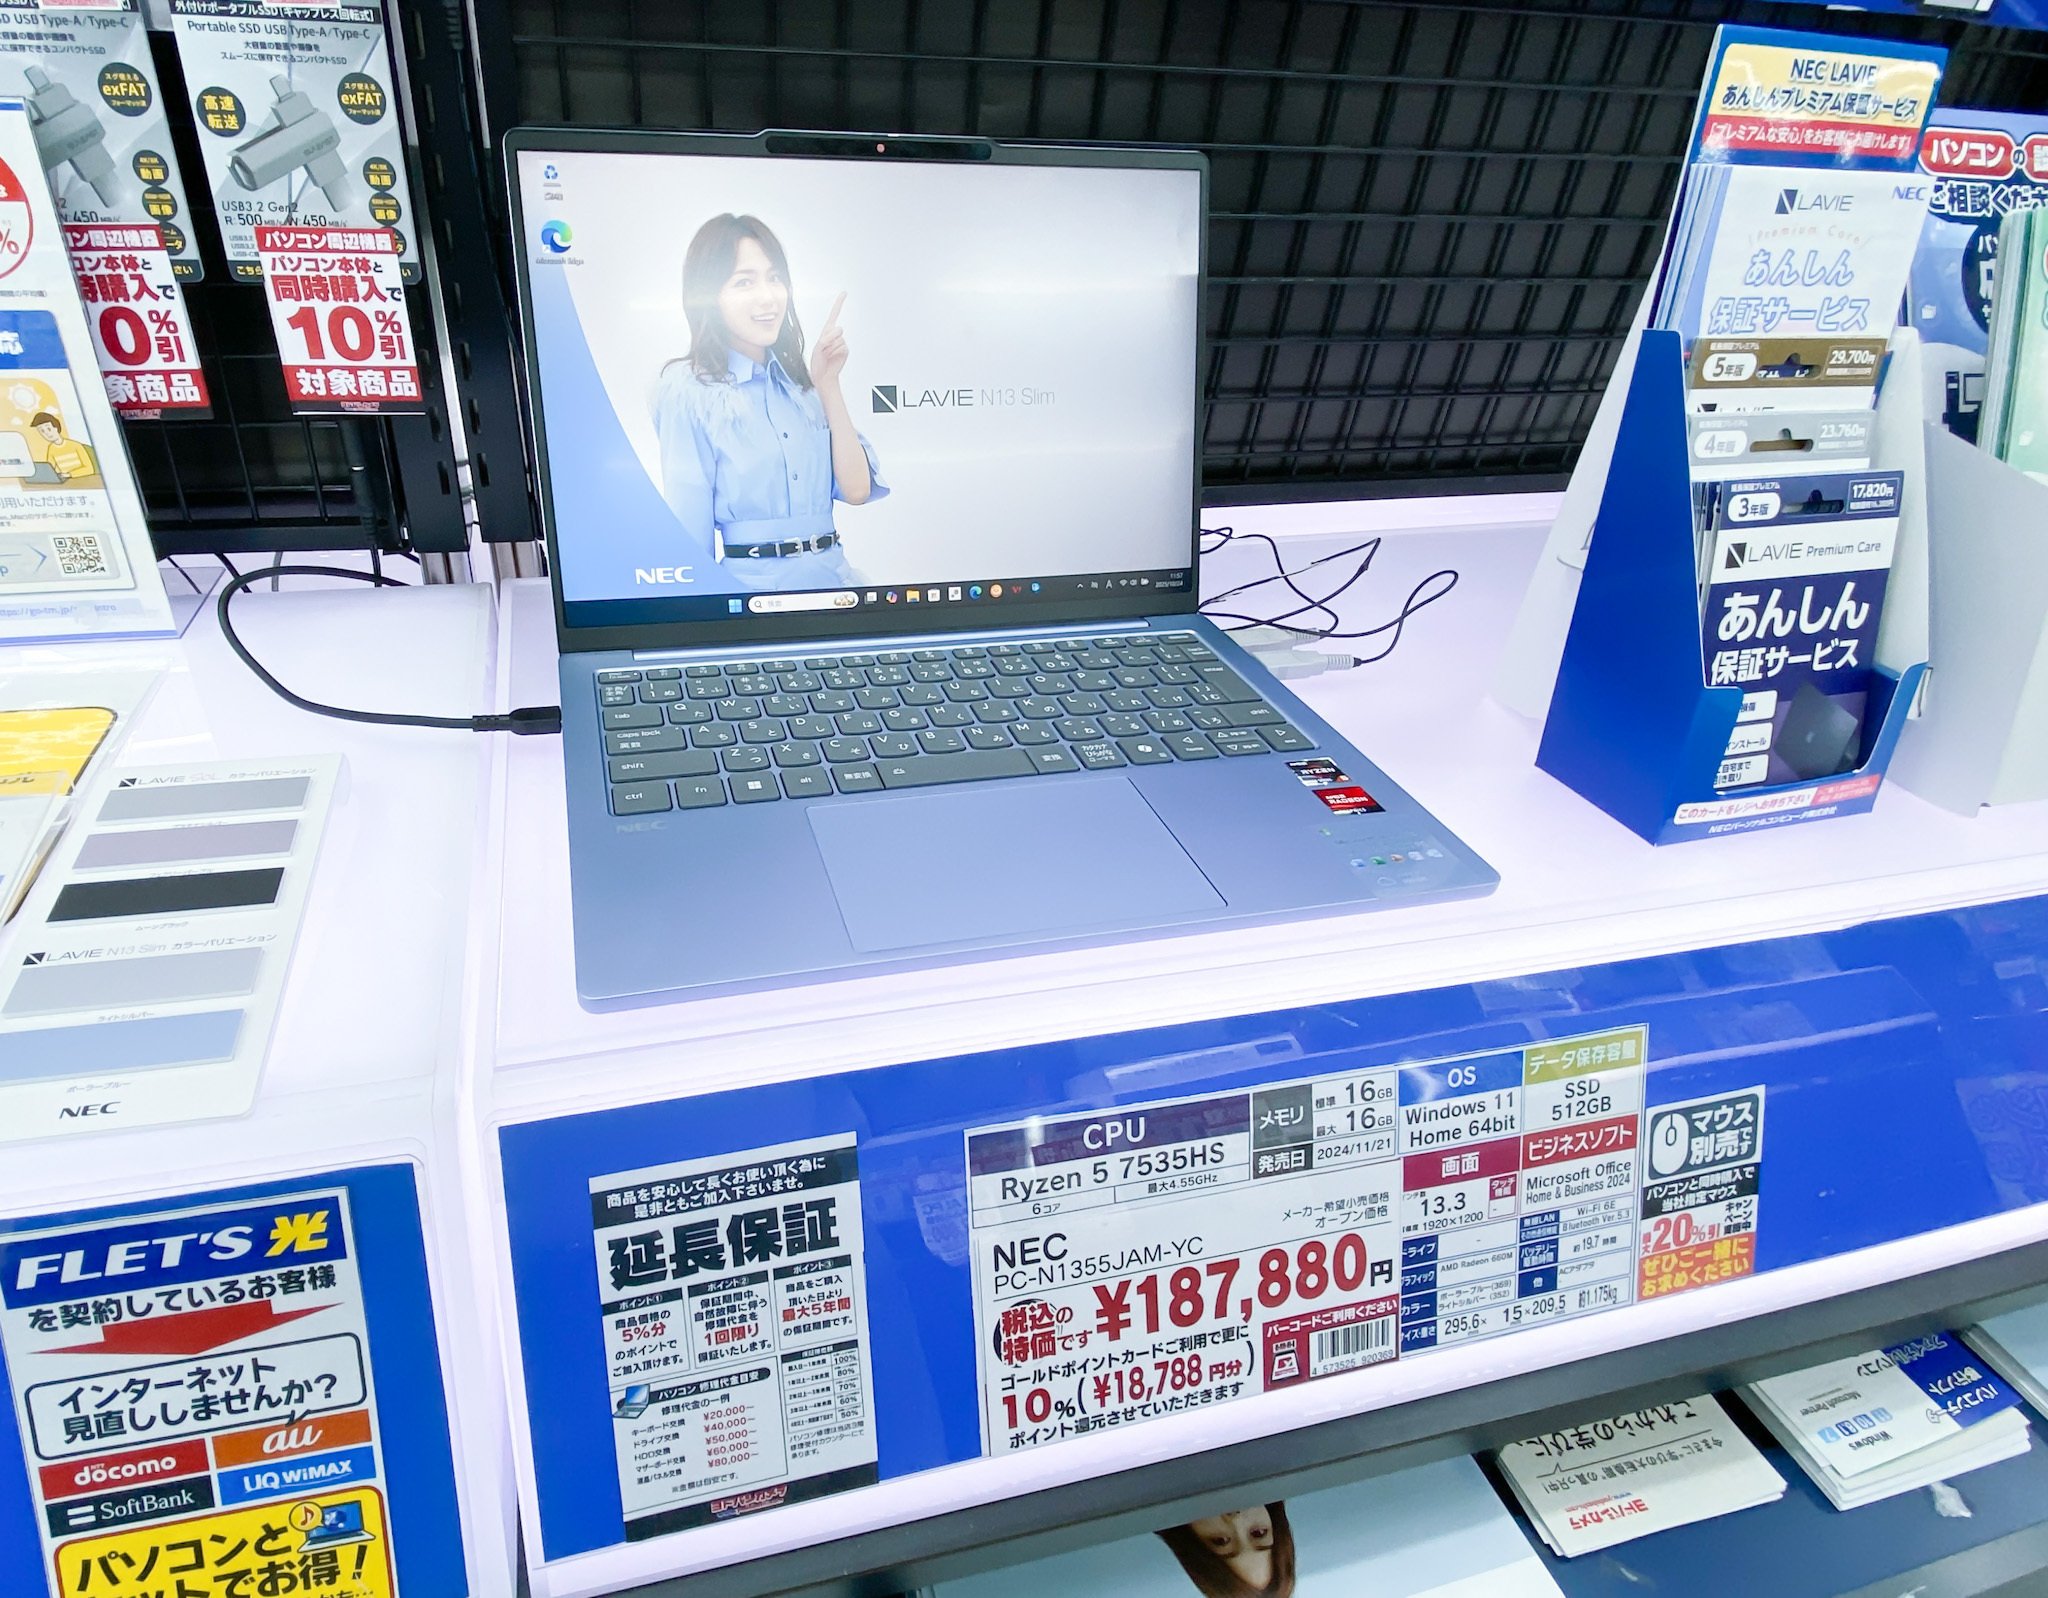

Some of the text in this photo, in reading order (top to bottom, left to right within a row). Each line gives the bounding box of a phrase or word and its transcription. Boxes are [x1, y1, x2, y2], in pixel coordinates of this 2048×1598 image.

[187, 20, 287, 35] Portable SSD USB
[221, 51, 347, 65] スムーズに保存できるコンパクトSSD
[1790, 58, 1877, 84] NEC LAVIE
[102, 83, 147, 96] exFAT
[341, 93, 382, 107] exFAT
[1721, 85, 1919, 118] あんしんプレミアム保証サービス
[203, 94, 236, 111] 高速
[207, 114, 240, 130] 転送
[1797, 195, 1854, 212] LAVIE
[1891, 186, 1927, 201] NEC
[222, 200, 299, 213] USB3.2 Gen2
[264, 232, 393, 251] パソコン周辺機器
[271, 256, 383, 274] パソコン本体と
[1744, 249, 1855, 287] あんしん
[271, 274, 402, 302] 同時購入で
[1710, 297, 1871, 333] 保証サービス
[1712, 356, 1744, 378] 5年版
[298, 368, 417, 397] 対象商品
[902, 386, 1056, 408] LAVIE N13 Slim
[1704, 434, 1736, 454] 4年版
[1738, 497, 1770, 517] 3年版
[1748, 541, 1881, 562] LAVIE Premium Care
[635, 566, 694, 585] NEC
[1717, 581, 1870, 642] あんしん
[1711, 639, 1859, 686] 保証サービス
[614, 712, 630, 720] tab
[621, 761, 645, 770] shift
[1300, 767, 1335, 775] RYZEN
[138, 775, 186, 785] LAVIE
[625, 792, 643, 800] ctrl
[46, 933, 278, 962] LAVIE N13 Slim カラーバリエーション
[1529, 1039, 1637, 1076] データ保存容量
[1447, 1065, 1477, 1089] OS
[1564, 1078, 1600, 1099] SSD
[59, 1100, 121, 1119] NEC
[1315, 1095, 1336, 1110] 標準
[1405, 1091, 1514, 1125] Windows 11
[1551, 1096, 1612, 1121] 512GB
[1259, 1104, 1304, 1132] メモリ
[1690, 1101, 1754, 1133] マウス
[1082, 1116, 1147, 1150] CPU
[1316, 1122, 1337, 1137] 最大
[1409, 1114, 1516, 1148] Home 64bit
[1317, 1137, 1392, 1161] 2024/11/21
[1528, 1124, 1633, 1162] ビジネスソフト
[1001, 1141, 1225, 1201] Ryzen 5 7535HS
[1258, 1150, 1306, 1173] 発売日
[1441, 1151, 1480, 1178] 画面
[607, 1156, 826, 1208] 商品を安心して長くお使い頂く為に
[1147, 1172, 1219, 1195] 最大4.55GHz
[1526, 1159, 1632, 1190] Microsoft Office
[1647, 1166, 1755, 1202] パソコンと同時購入で
[634, 1176, 804, 1219] 是非ともご加入下さいませ。
[1526, 1172, 1631, 1205] Home Business 2024
[1661, 1184, 1738, 1212] 当社指定マウス
[1032, 1201, 1061, 1215] 6コア
[1281, 1190, 1391, 1222] メーカー希望小売価格
[1420, 1192, 1467, 1217] 13.3
[1577, 1204, 1601, 1216] Wi-Fi
[1314, 1205, 1389, 1230] オープン価格
[1562, 1216, 1600, 1232] Bluetooth
[15, 1210, 330, 1291] FLET'S 光
[608, 1197, 840, 1291] 延長保証
[993, 1232, 1069, 1273] NEC
[1520, 1244, 1557, 1258] バッテリー
[993, 1236, 1204, 1294] PC-N1355JAM-YC
[1642, 1236, 1750, 1277] ぜひご一緒に
[786, 1275, 843, 1293] 商品をご購入
[1641, 1257, 1750, 1297] お求めください
[28, 1264, 337, 1332] を契約しているお客様
[700, 1290, 760, 1309] 保証期間中、
[783, 1297, 851, 1322] 最大5年間
[789, 1289, 843, 1307] 頂いた日より
[615, 1310, 671, 1330] 商品価格の
[705, 1311, 758, 1331] 修理代金を
[783, 1315, 853, 1336] の保証期間です。
[1002, 1302, 1074, 1337] 税込の
[1266, 1298, 1398, 1338] バーコードご利用ください
[622, 1321, 667, 1342] 5%分
[704, 1322, 759, 1346] 1回限り
[615, 1340, 677, 1361] のポイントで
[698, 1339, 772, 1362] 保証いたします。
[1001, 1324, 1250, 1392] ゴールドポイントカードご利用で更に
[1003, 1329, 1093, 1366] 特価です
[613, 1354, 684, 1377] ご加入頂けます。
[834, 1354, 857, 1366] 100%
[837, 1367, 855, 1377] 80%
[1322, 1359, 1357, 1374] 573525
[59, 1357, 277, 1414] インターネット
[658, 1371, 760, 1400] パソコン 修理代金目安
[839, 1381, 857, 1391] 70%
[63, 1373, 338, 1444] 見直ししませんか?
[661, 1393, 731, 1416] 修理代金の一例
[840, 1396, 858, 1405] 60%
[1925, 1383, 1999, 1424] パソコンデータ
[841, 1409, 859, 1419] 50%
[1009, 1380, 1245, 1450] ポイント還元させていただきます
[262, 1423, 324, 1453] au
[633, 1432, 680, 1449] ドライブ交換
[1848, 1430, 1893, 1451] Windows
[74, 1455, 177, 1486] docomo
[242, 1458, 353, 1493] UQ WiMAX
[100, 1488, 196, 1520] SoftBank
[1569, 1499, 1649, 1530] ヨドバシカメラ
[76, 1522, 293, 1592] パソコンと
